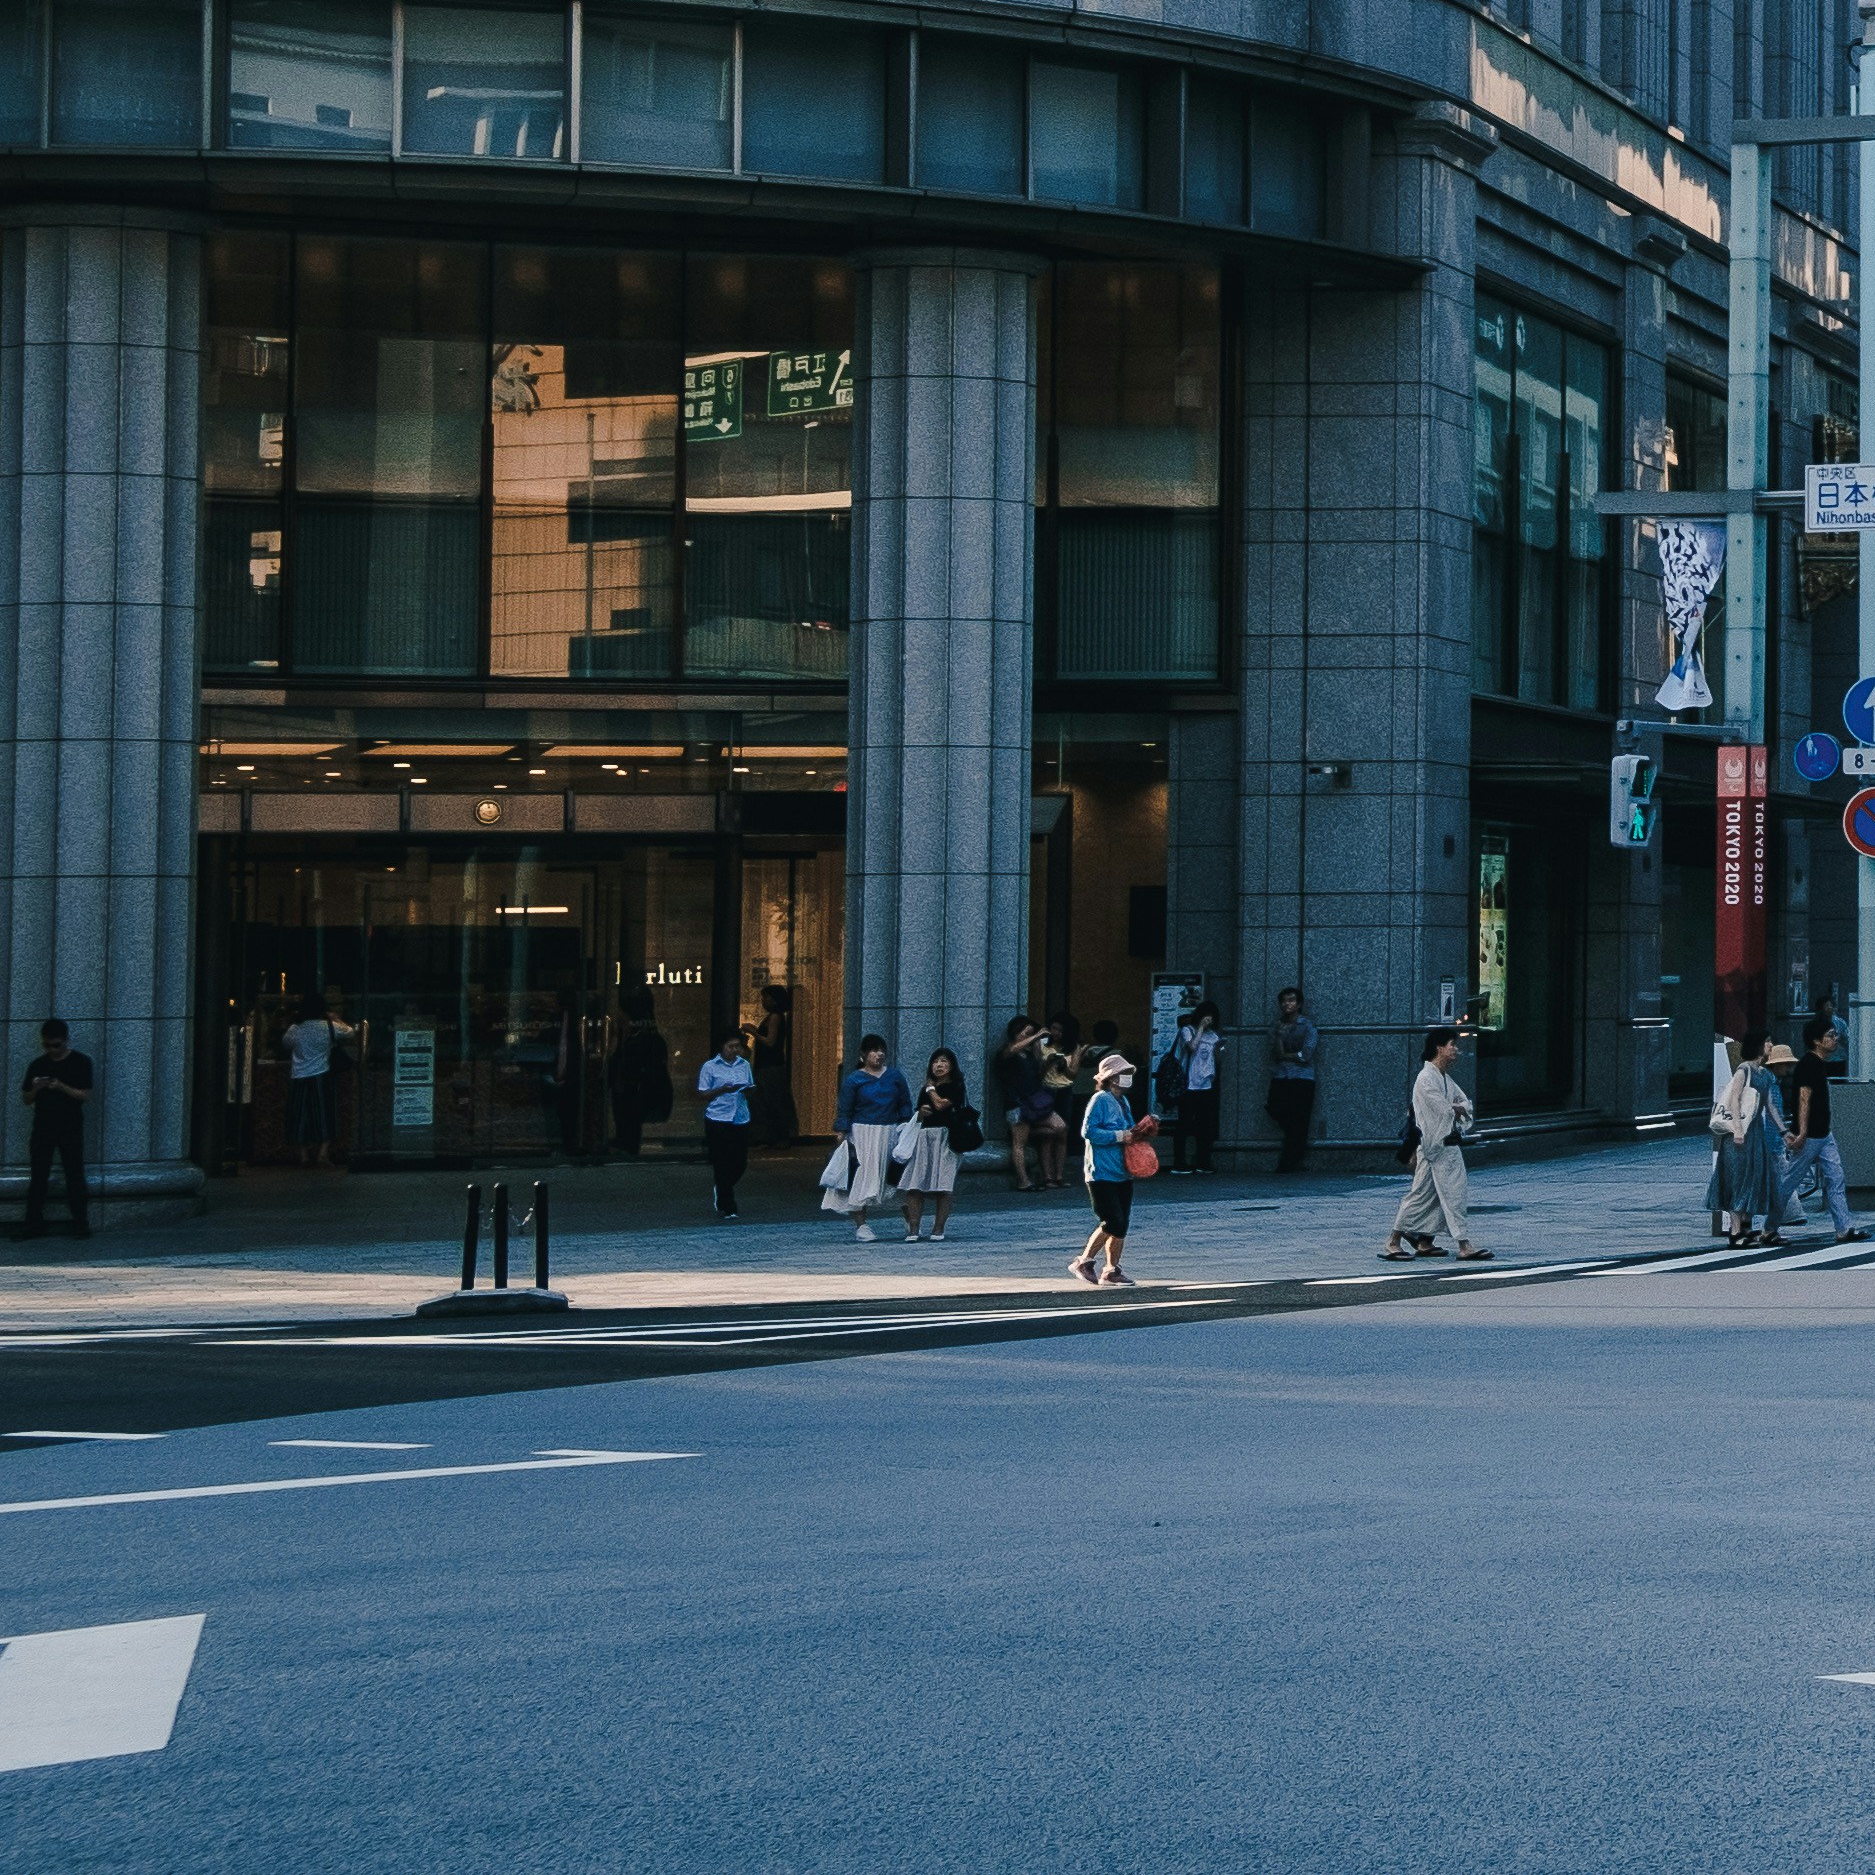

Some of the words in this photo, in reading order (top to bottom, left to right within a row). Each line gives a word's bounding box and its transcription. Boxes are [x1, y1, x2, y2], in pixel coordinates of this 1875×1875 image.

[1816, 467, 1856, 481] 中央区
[1725, 801, 1741, 859] TOKYO
[1755, 802, 1764, 859] TOKYO
[1725, 861, 1740, 905] 2020
[1755, 862, 1764, 905] 2020
